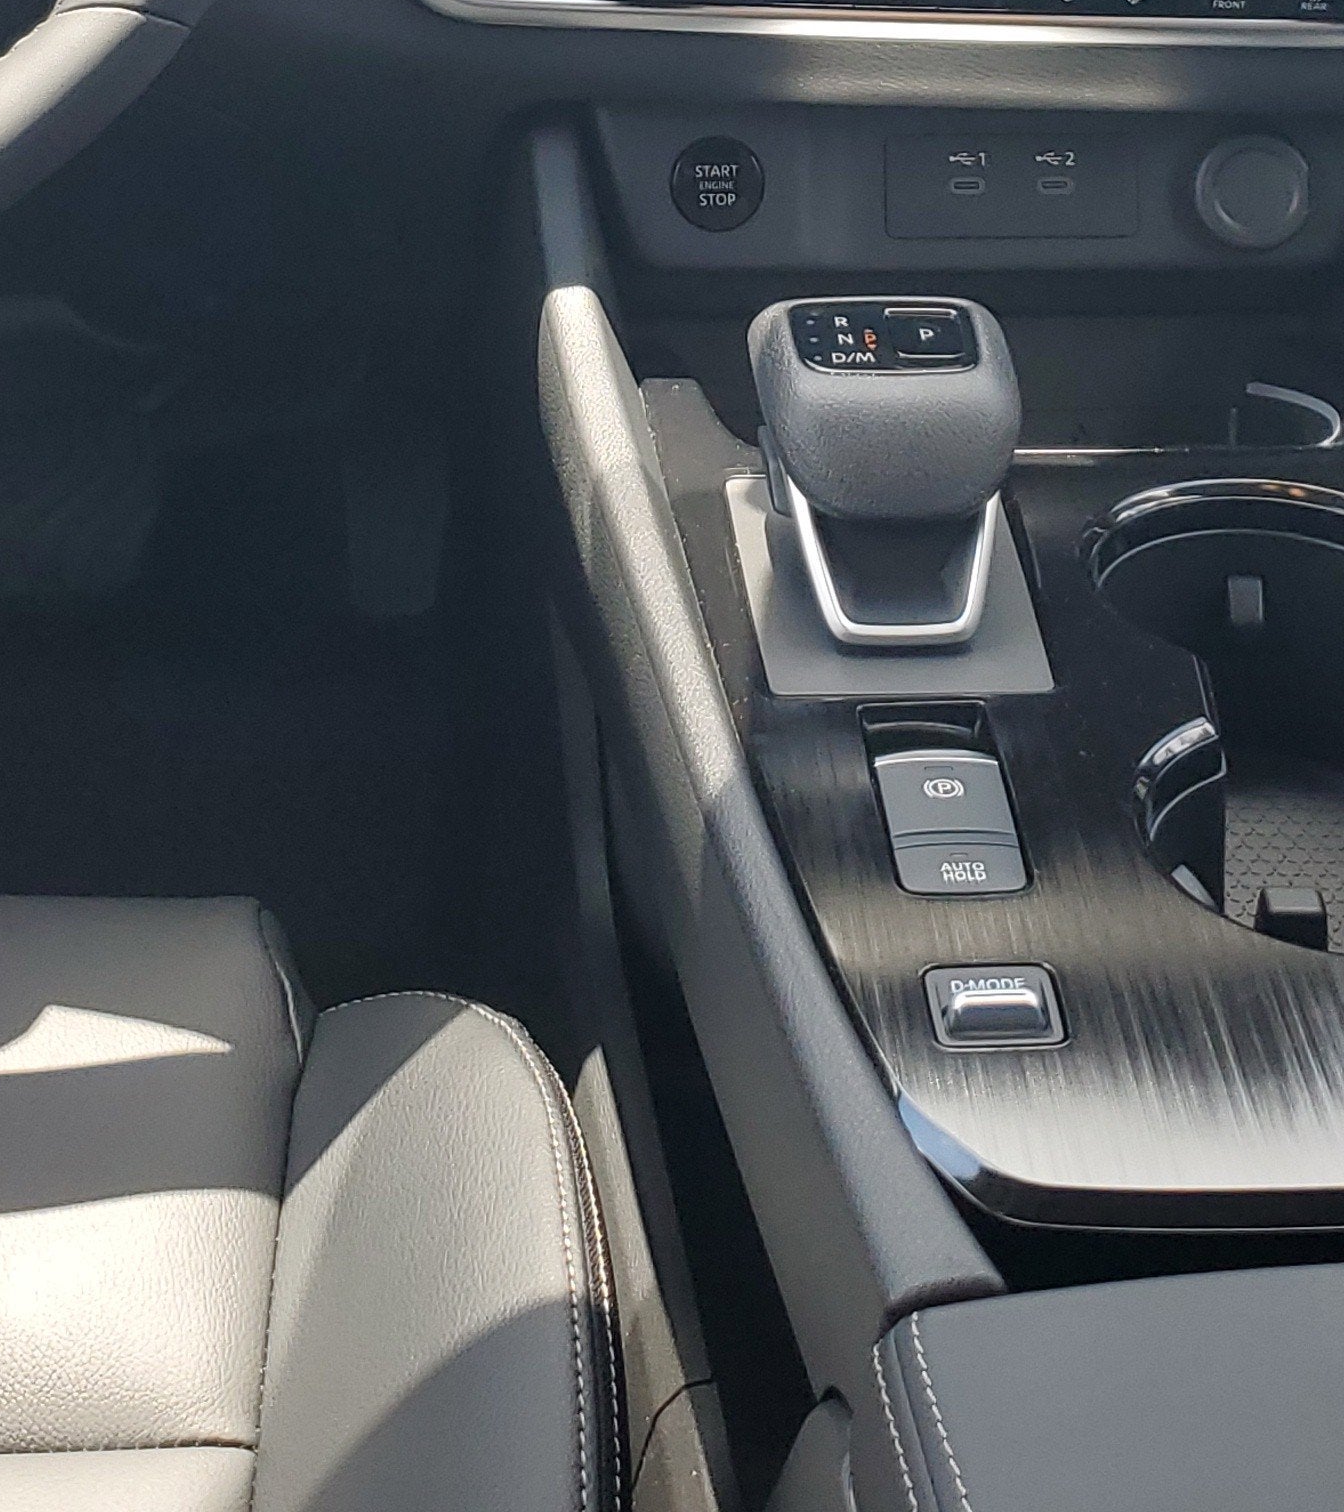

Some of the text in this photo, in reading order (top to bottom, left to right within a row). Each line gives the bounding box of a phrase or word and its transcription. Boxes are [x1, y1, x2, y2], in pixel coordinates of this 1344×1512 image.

[1212, 0, 1246, 10] FRONT
[1301, 2, 1327, 11] REAR
[978, 152, 987, 166] 1
[1064, 152, 1075, 167] 2
[695, 164, 739, 178] START
[699, 193, 736, 207] STOP
[833, 315, 849, 328] R
[837, 333, 854, 345] N
[918, 327, 934, 341] P
[831, 351, 876, 364] D/M
[940, 861, 985, 872] AUTO
[942, 870, 987, 883] HOLD
